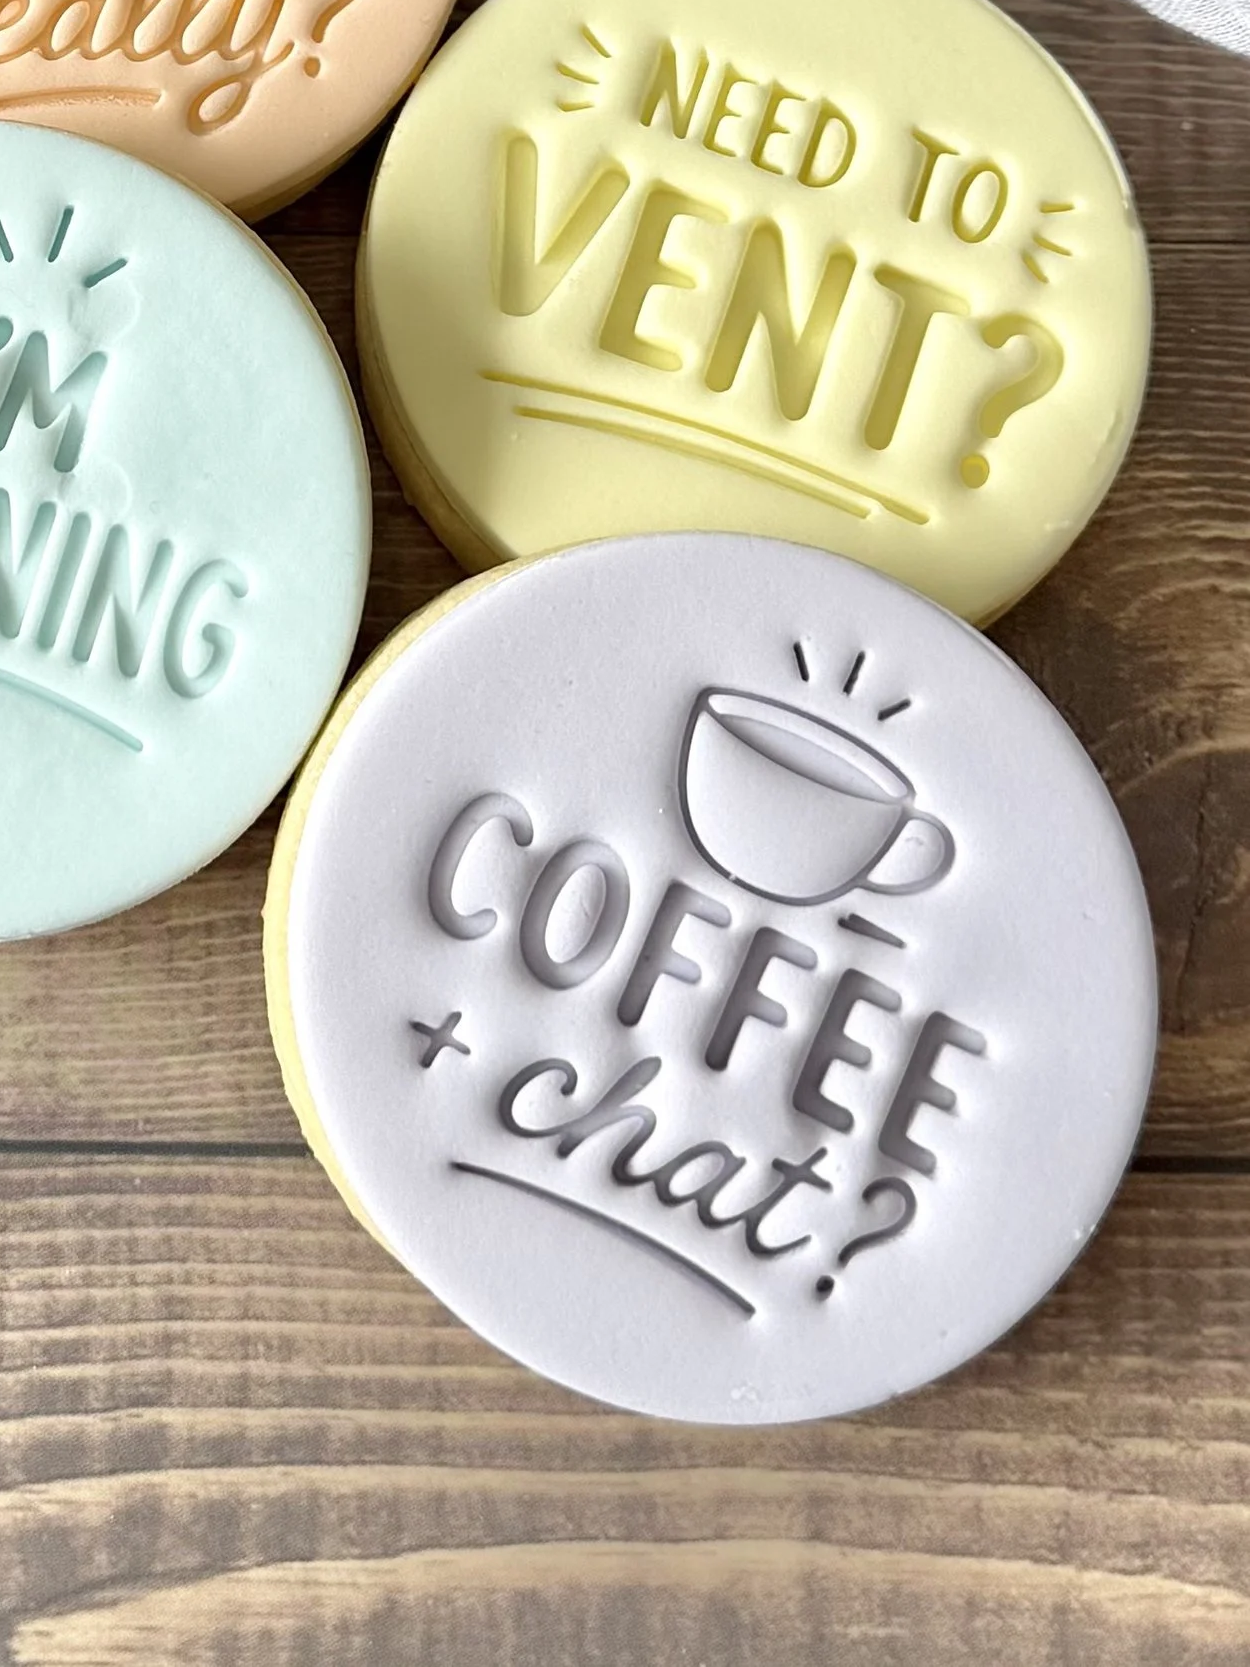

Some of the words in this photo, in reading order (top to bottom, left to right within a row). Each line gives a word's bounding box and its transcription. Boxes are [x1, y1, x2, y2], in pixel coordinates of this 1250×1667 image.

[639, 39, 857, 188] NEED
[908, 126, 1008, 244] TO
[498, 131, 1065, 489] VENT?
[427, 792, 988, 1175] COFFEE
[498, 1056, 917, 1298] chat?
